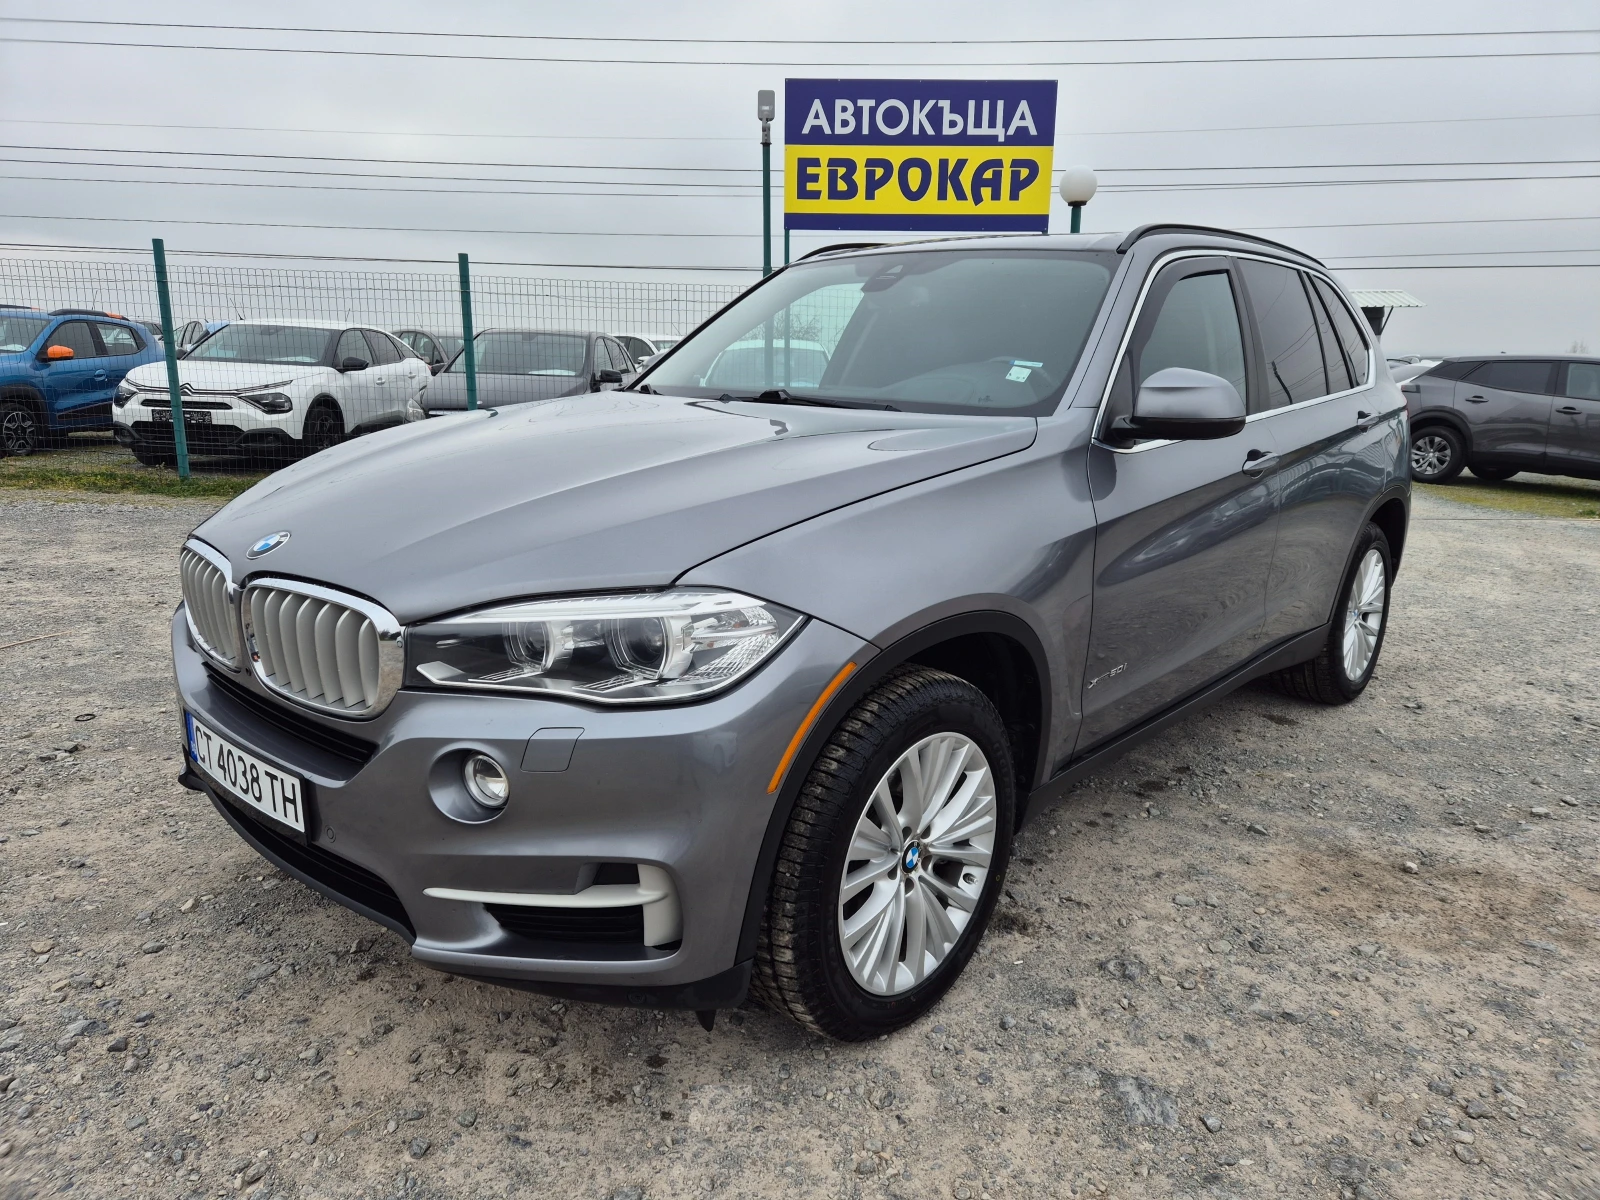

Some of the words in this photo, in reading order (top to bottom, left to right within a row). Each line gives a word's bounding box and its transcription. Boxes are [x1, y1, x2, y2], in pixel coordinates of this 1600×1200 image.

[801, 98, 1038, 142] АВТОКЪЩА
[796, 157, 1040, 207] ЕВРОКАР
[195, 725, 212, 770] CT
[217, 743, 262, 803] 4038
[264, 770, 299, 823] TH
